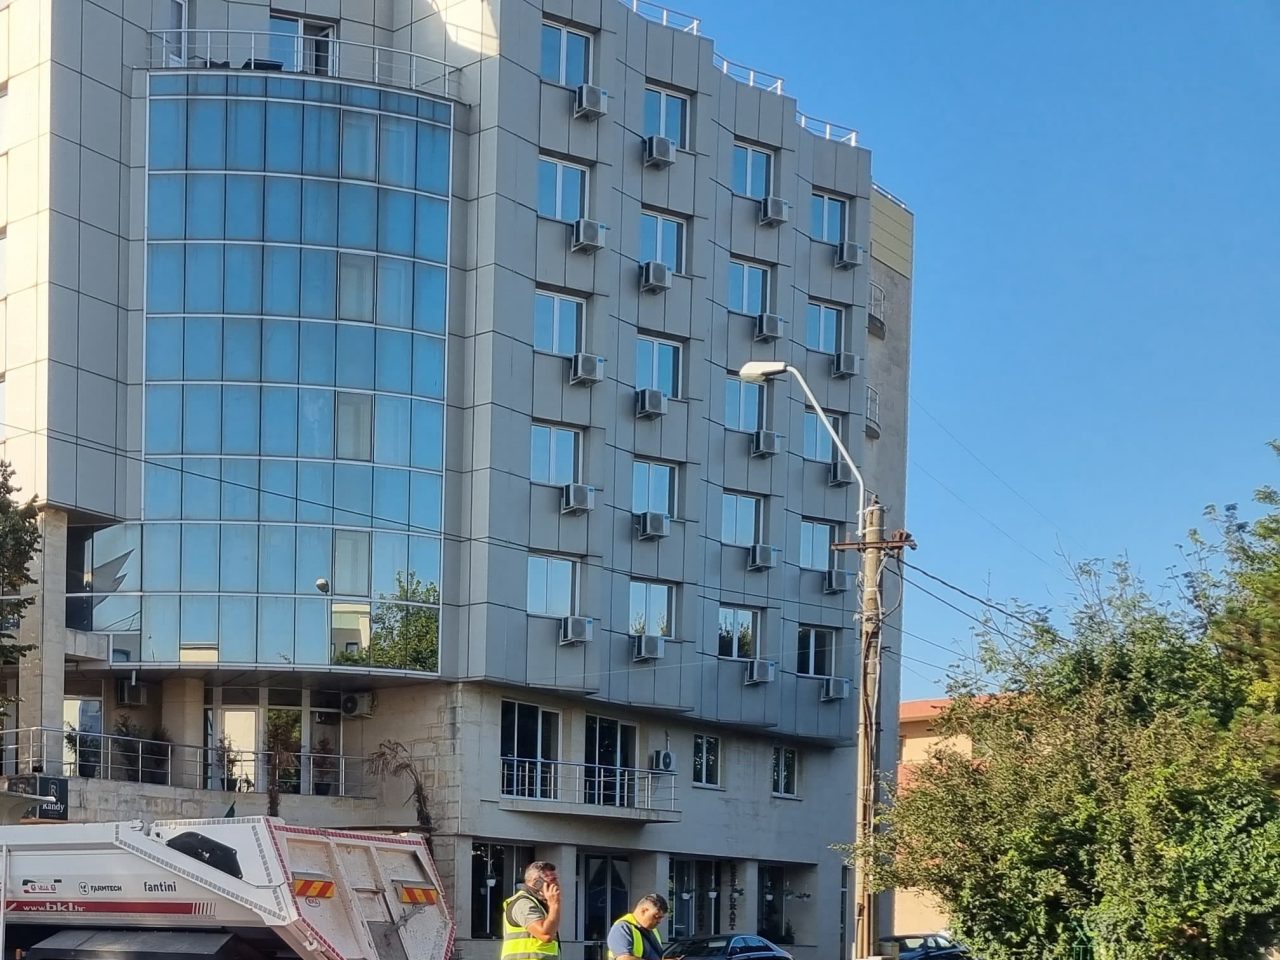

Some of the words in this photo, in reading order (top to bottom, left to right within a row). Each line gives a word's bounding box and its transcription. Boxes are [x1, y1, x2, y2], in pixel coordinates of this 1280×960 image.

[90, 885, 122, 894] FARMTECH
[143, 881, 177, 893] fantini
[22, 902, 86, 912] www.bkl.hr
